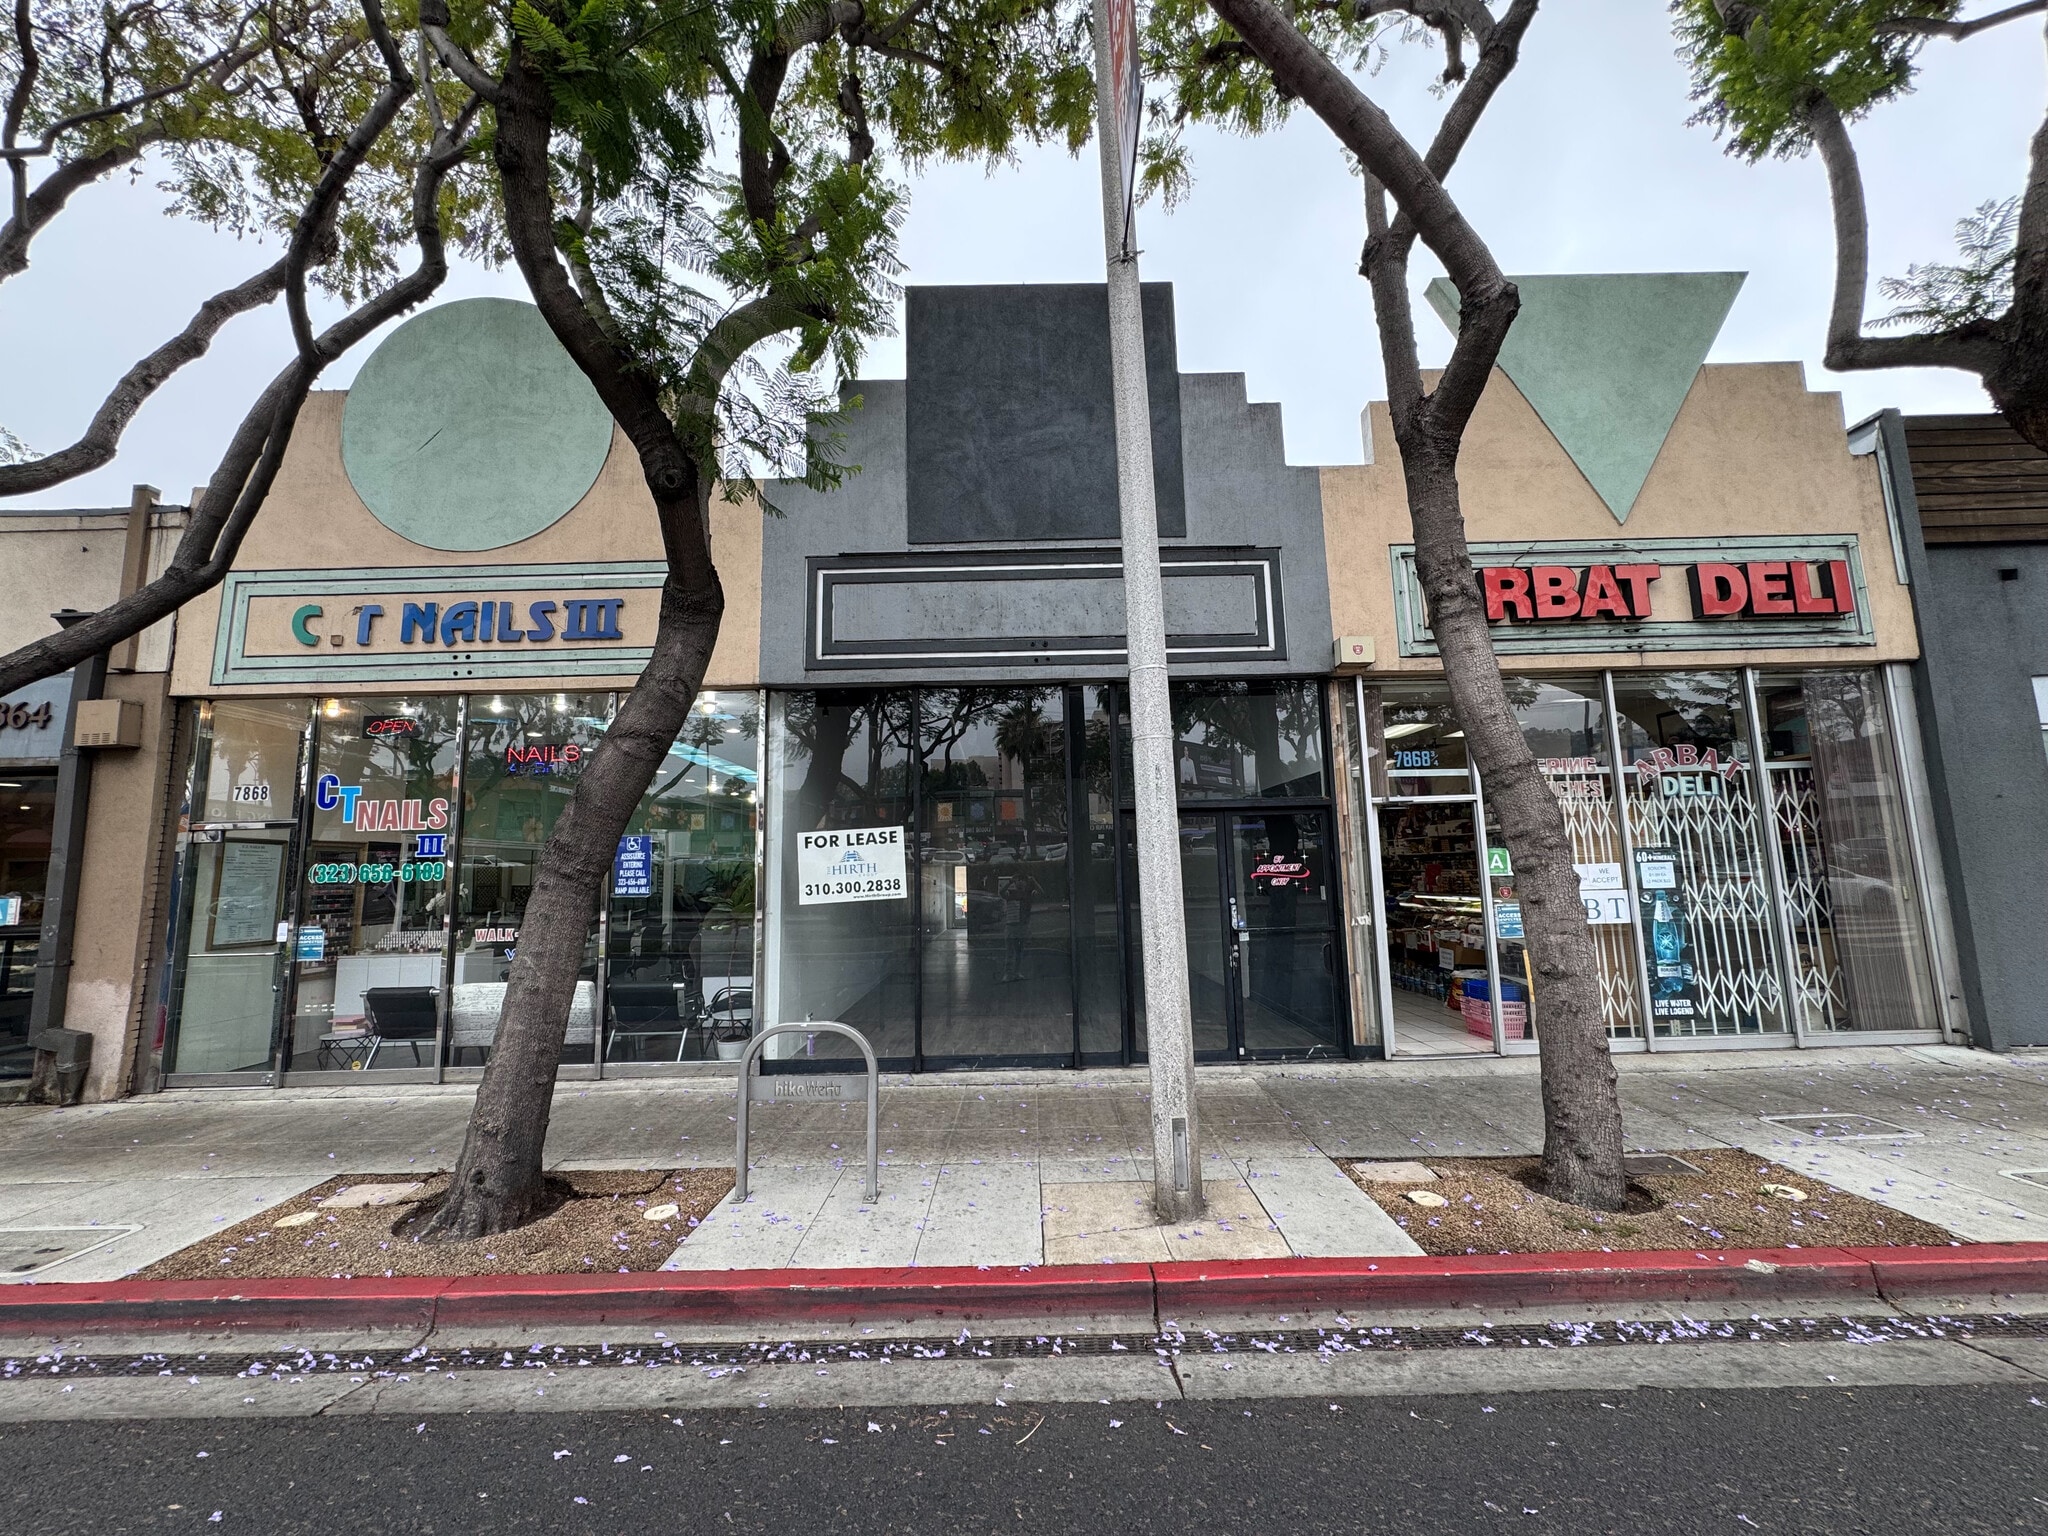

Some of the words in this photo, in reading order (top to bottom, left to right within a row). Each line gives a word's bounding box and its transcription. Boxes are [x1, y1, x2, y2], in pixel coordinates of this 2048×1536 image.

[1688, 560, 1854, 618] DELI
[400, 601, 556, 647] NAILS
[560, 598, 624, 641] III
[369, 719, 417, 733] OPEN
[507, 744, 580, 763] NAILS
[1394, 750, 1431, 768] 7868
[1633, 744, 1744, 786] ARBAT
[234, 786, 268, 801] 7868
[1661, 776, 1719, 797] DELI
[355, 798, 449, 832] NAILS
[804, 834, 840, 849] FOR
[846, 831, 898, 847] LEASE
[1256, 863, 1302, 873] APPOINTMENT
[1273, 855, 1285, 863] BY
[1490, 854, 1504, 869] A
[308, 863, 358, 884] (323)
[358, 861, 445, 883] 656-6189
[832, 862, 878, 876] HIRTH
[805, 878, 901, 896] 310.300.2838
[1271, 877, 1290, 886] ONLY
[1592, 877, 1618, 885] ACCEPT
[1655, 1007, 1669, 1015] LIVE
